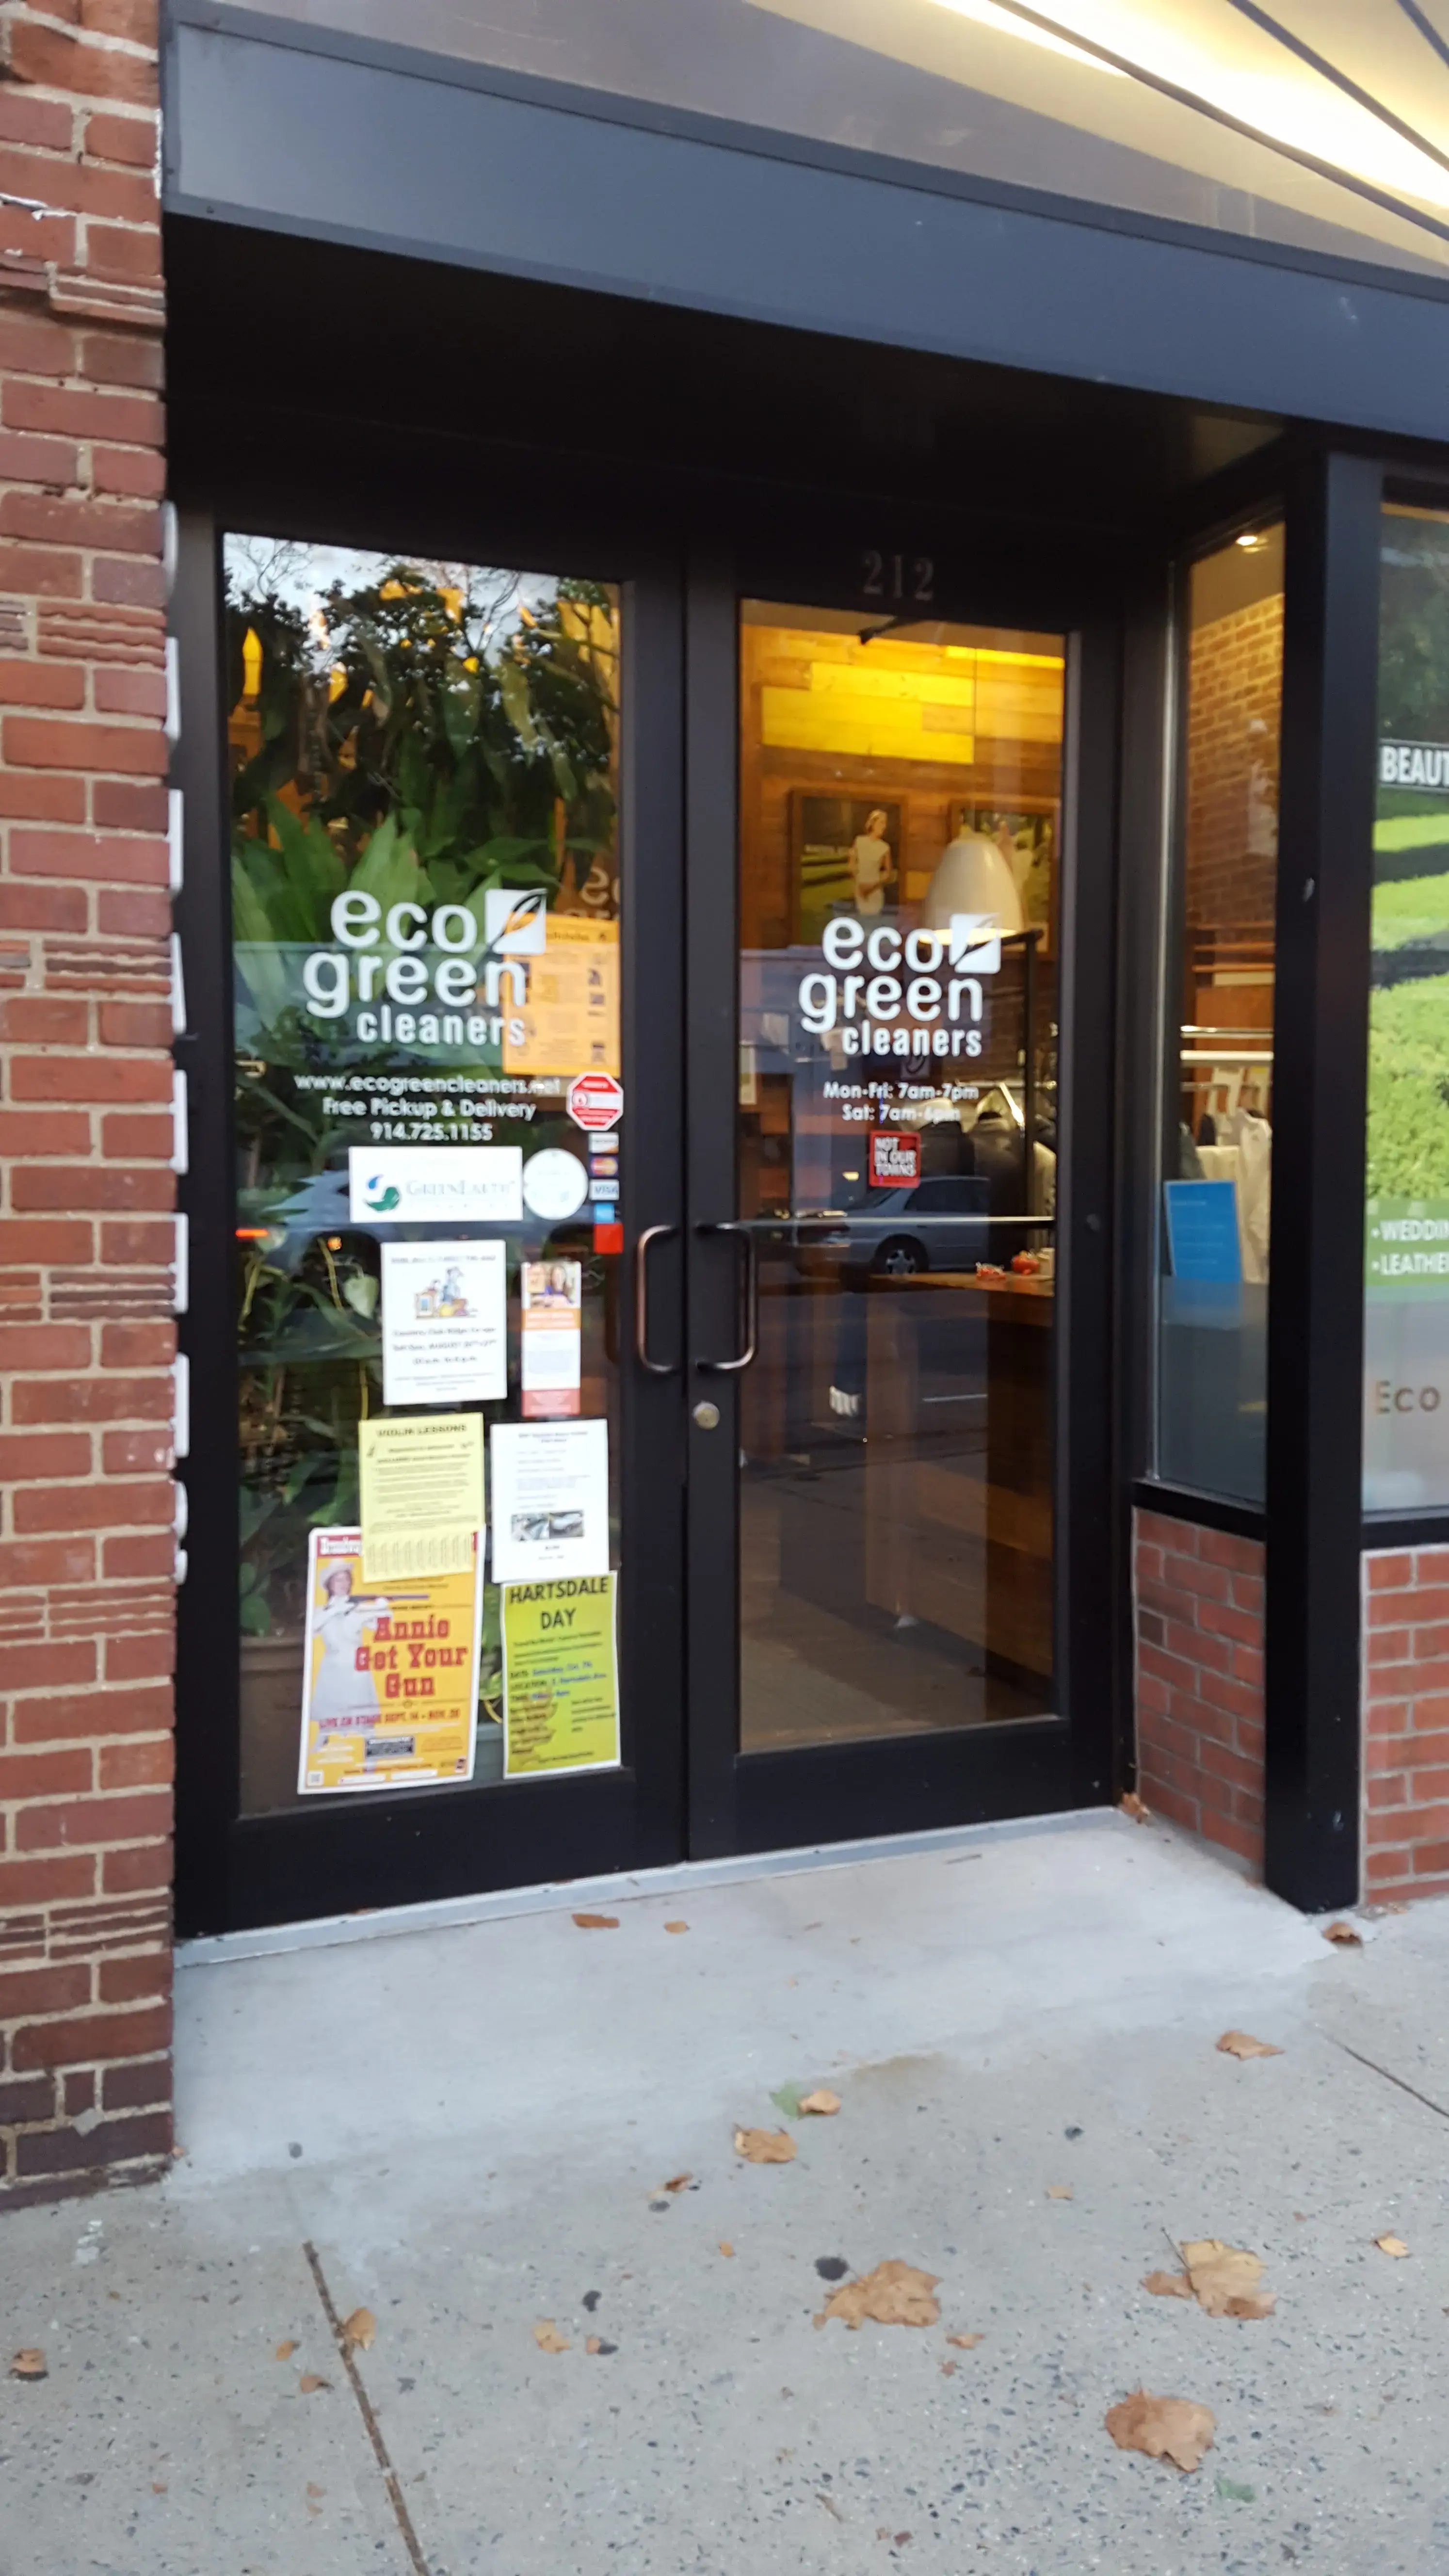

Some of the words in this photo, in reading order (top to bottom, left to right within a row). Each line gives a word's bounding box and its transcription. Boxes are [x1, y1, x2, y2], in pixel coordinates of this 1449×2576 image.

[863, 550, 934, 601] 212
[331, 890, 478, 953] eco
[822, 917, 943, 973] eco
[303, 952, 526, 1018] green
[799, 973, 982, 1033] green
[357, 1005, 526, 1046] cleaners
[842, 1020, 982, 1057] cleaners
[322, 1097, 367, 1116] Free
[370, 1097, 437, 1120] Pickup
[440, 1098, 455, 1116] &
[459, 1098, 536, 1121] Delivery
[842, 1103, 875, 1121] Sat:
[370, 1121, 493, 1142] 914.725.1155
[874, 1137, 899, 1151] NOT
[874, 1150, 888, 1163] IN
[889, 1150, 917, 1164] OUR
[874, 1162, 917, 1176] TOWNS
[510, 1577, 609, 1604] HARTSDALE
[540, 1607, 577, 1630] DAY
[407, 1642, 469, 1669] Your
[385, 1673, 435, 1699] Gun
